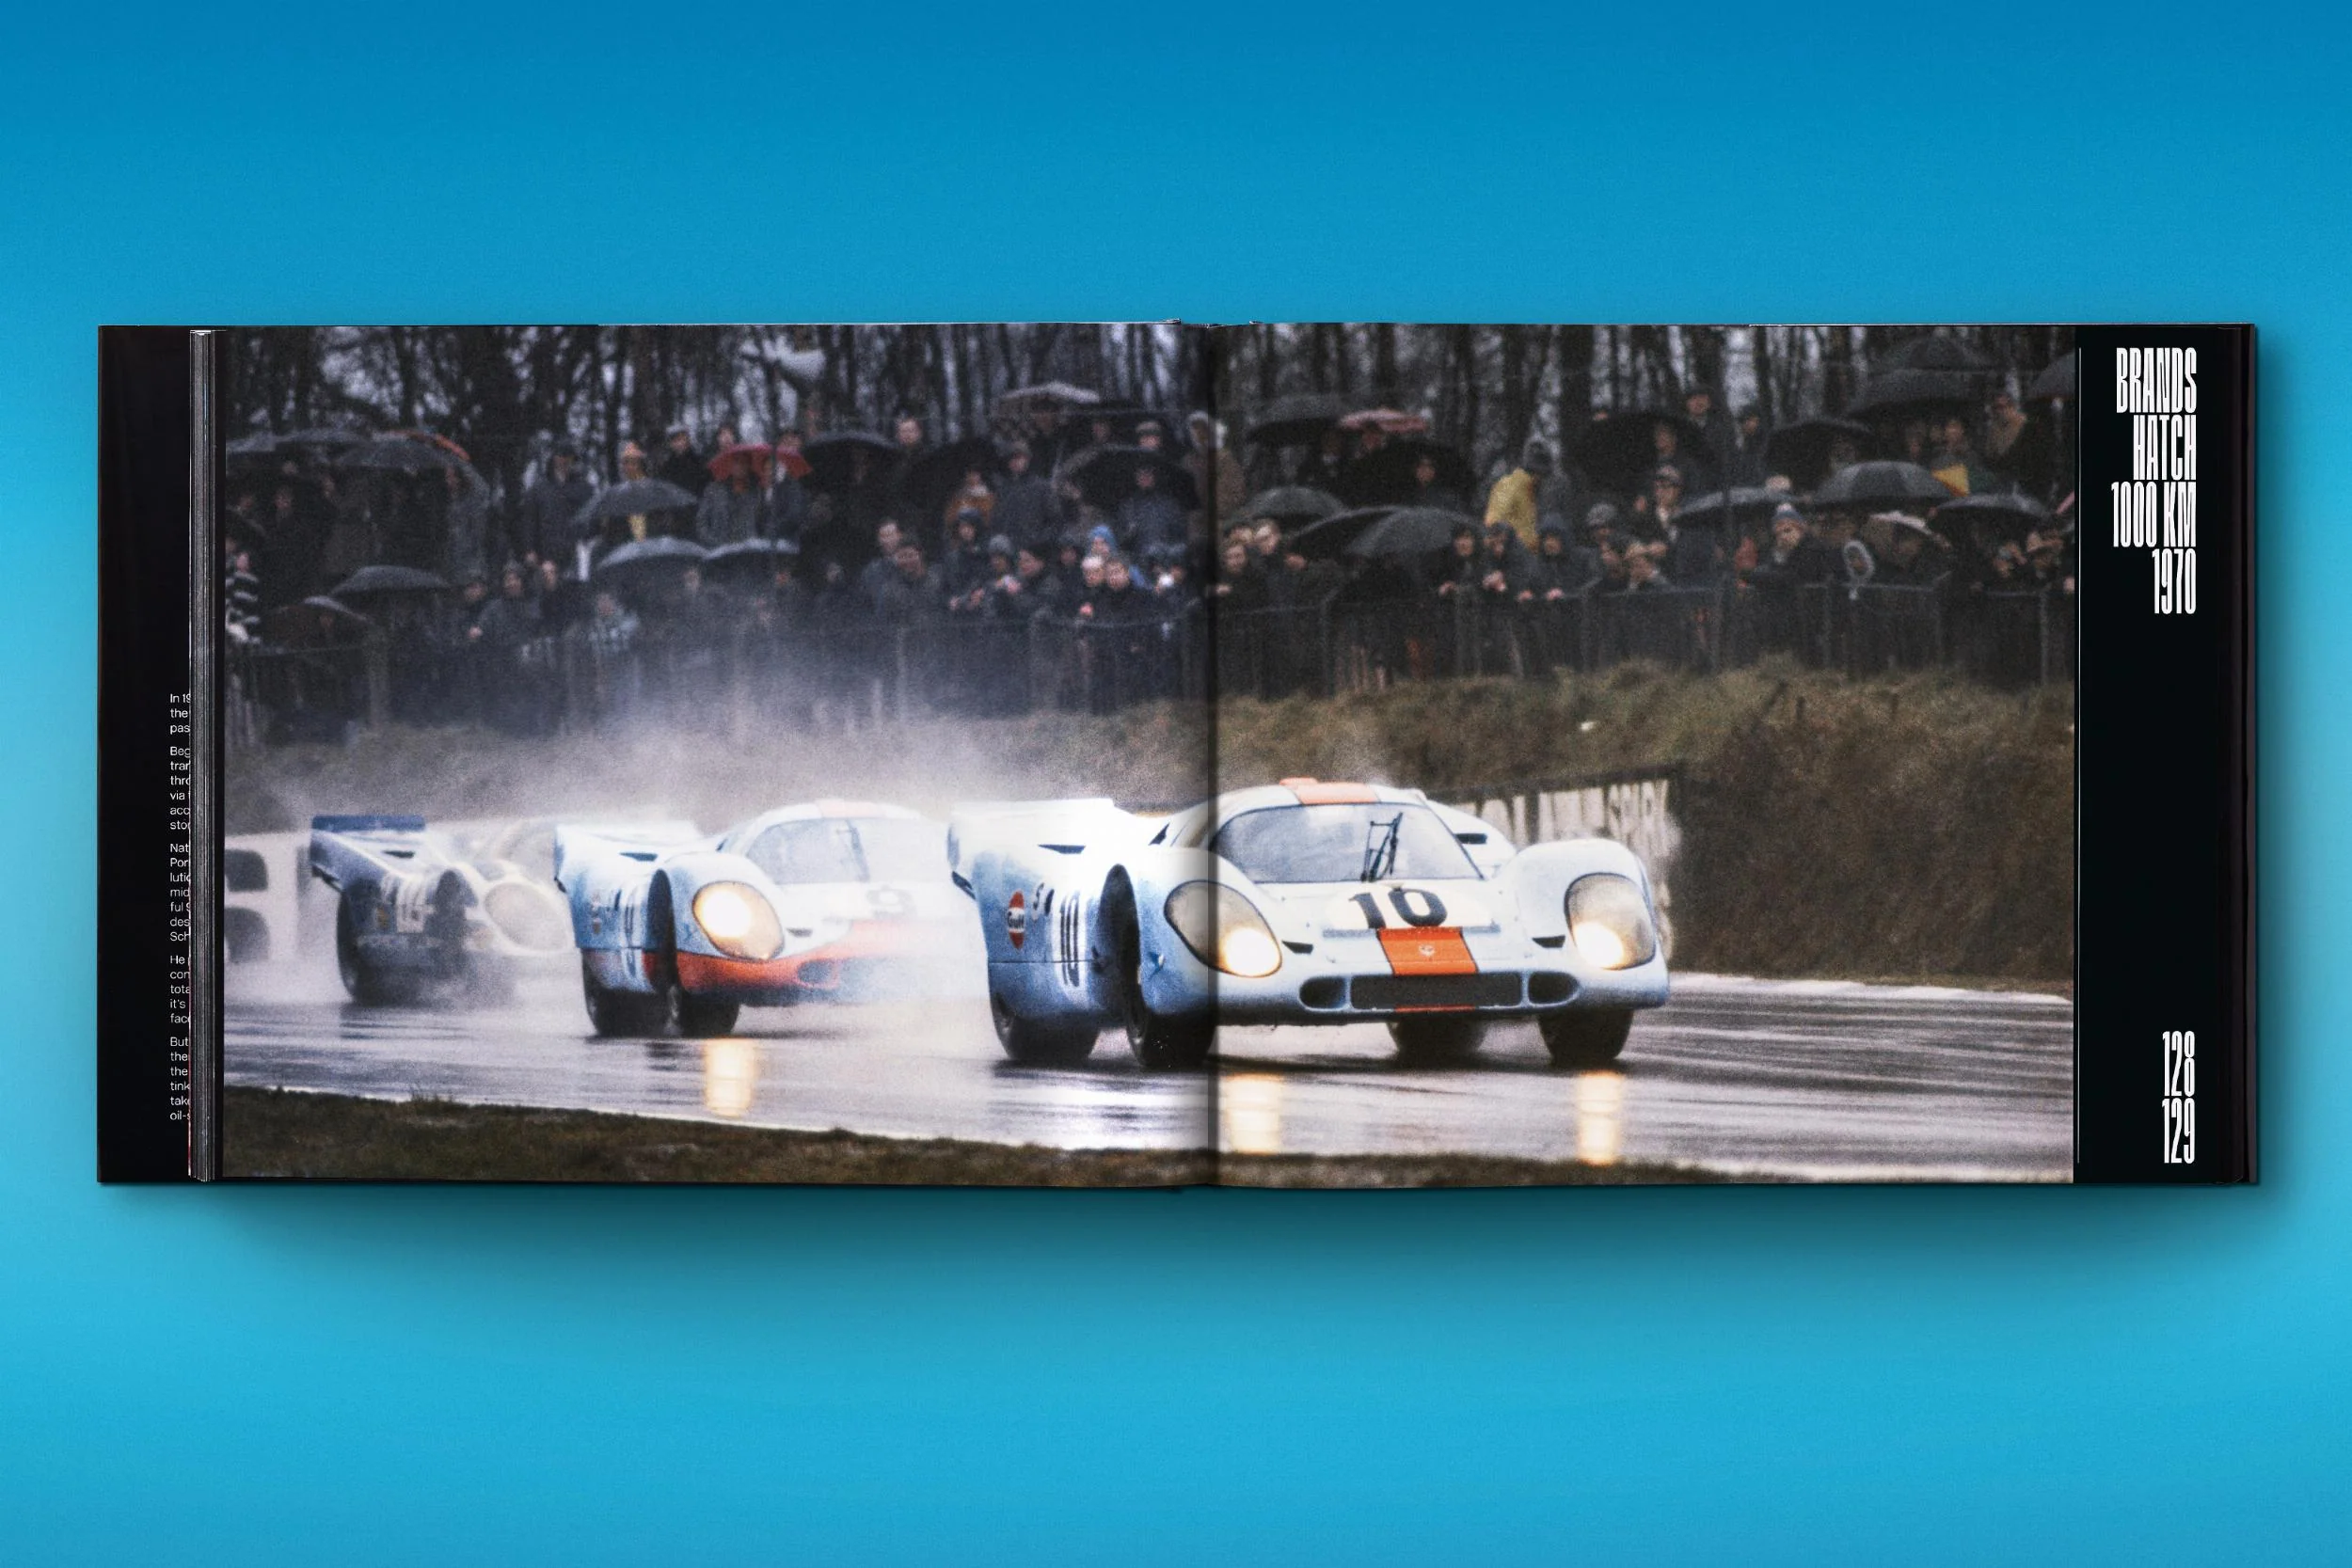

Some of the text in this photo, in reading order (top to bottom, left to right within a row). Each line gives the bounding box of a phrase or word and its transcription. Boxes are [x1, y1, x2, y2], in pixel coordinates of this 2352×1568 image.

[2117, 347, 2197, 413] BRANDS
[2133, 415, 2197, 481] HATCH
[2111, 481, 2197, 547] 1000 KM
[2152, 547, 2197, 614] 1970
[170, 693, 180, 704] In
[170, 707, 189, 719] the
[170, 724, 191, 736] pas
[170, 746, 191, 759] Beg
[170, 790, 185, 800] via
[170, 820, 190, 831] sto
[170, 843, 189, 853] Nat
[170, 858, 189, 868] Por
[170, 901, 183, 912] ful
[1348, 888, 1448, 929] 10
[170, 916, 191, 927] des
[170, 955, 184, 965] He
[170, 998, 186, 1009] it's
[170, 1036, 188, 1047] But
[170, 1051, 188, 1062] the
[2162, 1030, 2195, 1097] 128
[170, 1066, 188, 1077] the
[2162, 1098, 2195, 1164] 129
